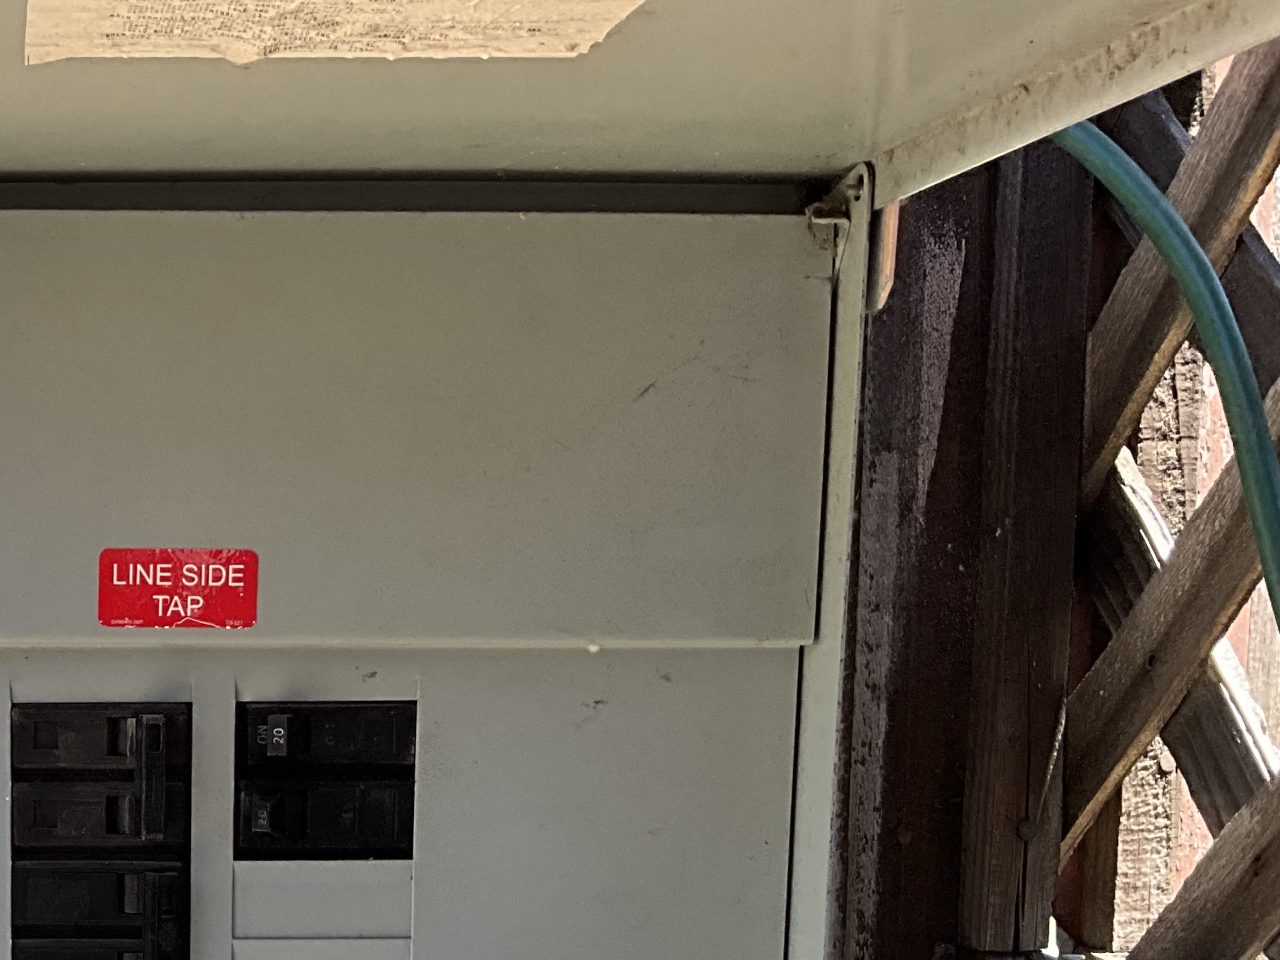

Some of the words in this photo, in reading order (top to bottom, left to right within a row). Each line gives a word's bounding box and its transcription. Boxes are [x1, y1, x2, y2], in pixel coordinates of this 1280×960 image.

[113, 563, 173, 586] LINE
[181, 563, 245, 587] SIDE
[152, 595, 204, 617] TAP
[273, 727, 284, 744] 20
